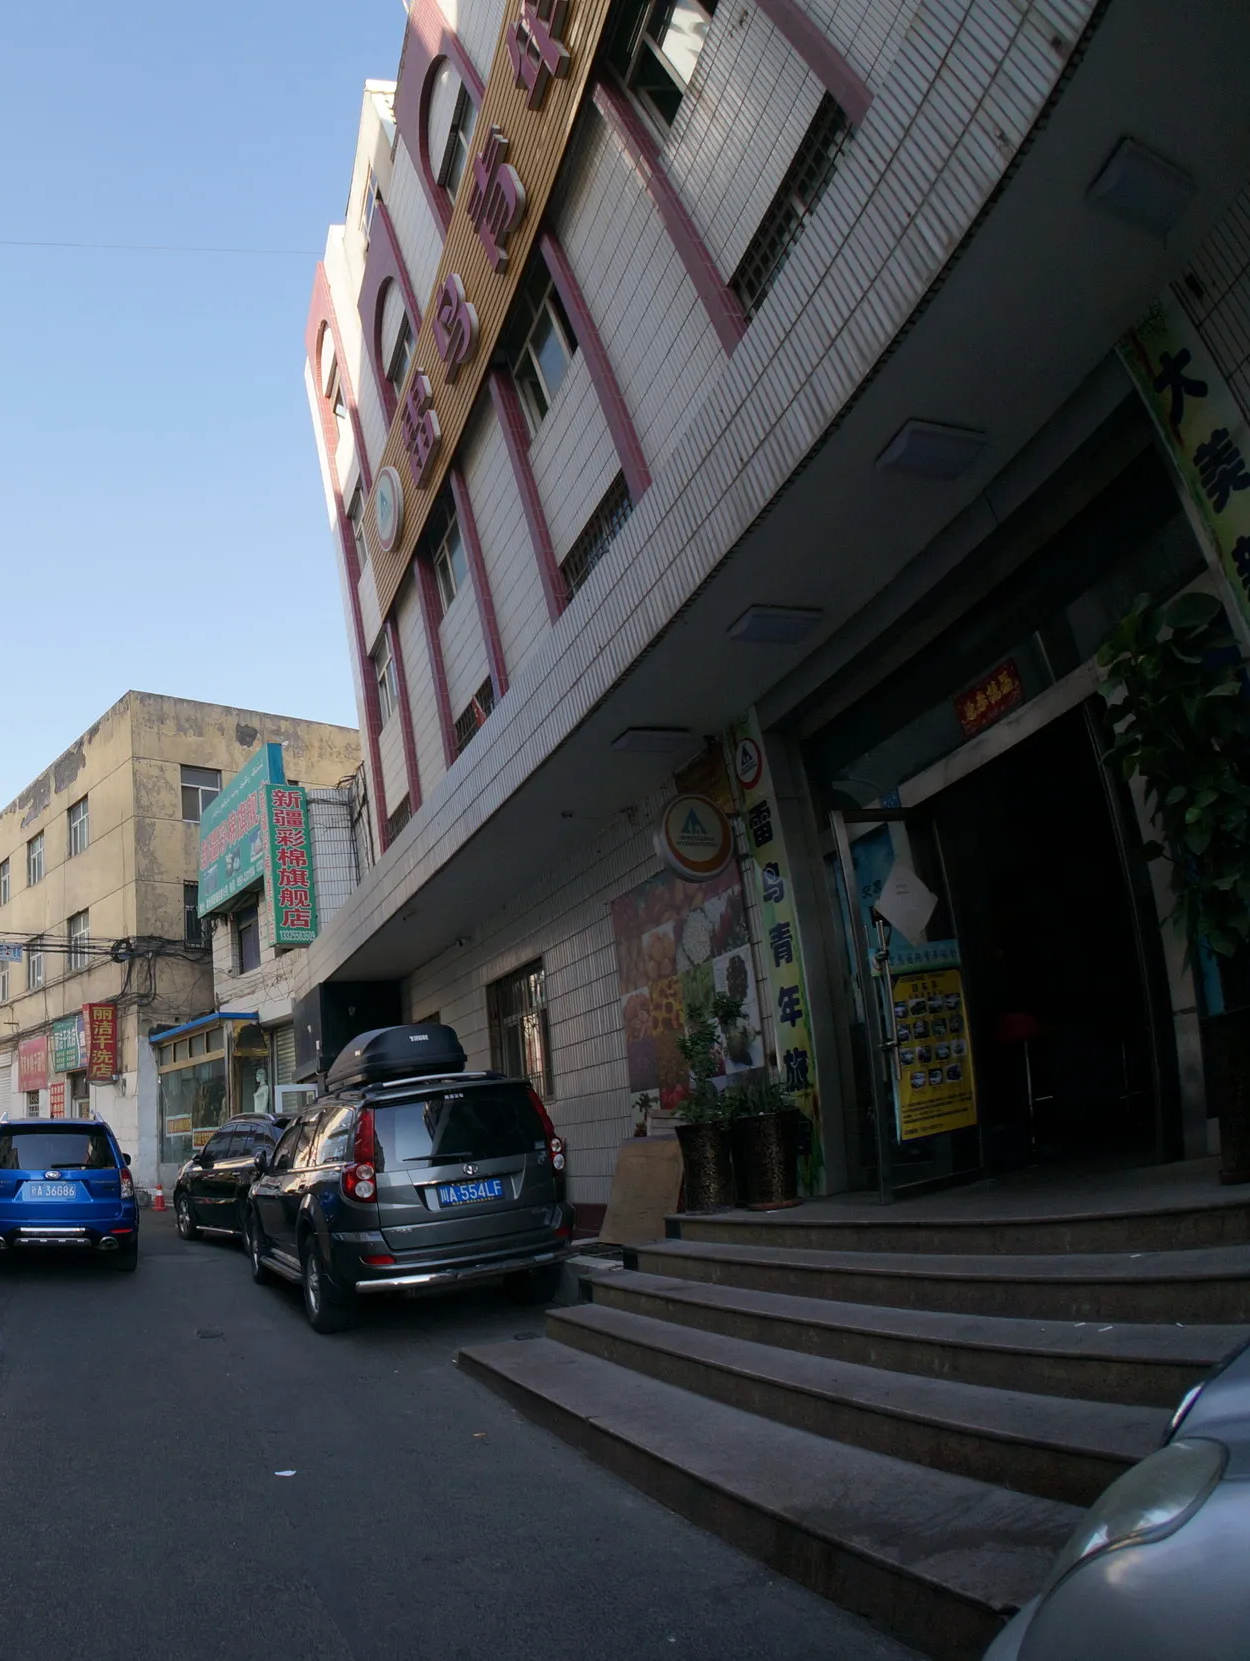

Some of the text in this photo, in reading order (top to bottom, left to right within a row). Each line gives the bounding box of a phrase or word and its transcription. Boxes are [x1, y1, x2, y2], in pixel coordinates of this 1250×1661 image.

[201, 779, 269, 871] 新疆彩棉旗舰
[272, 789, 312, 929] 新疆彩棉旗舰店
[92, 1006, 114, 1078] 丽洁干洗店
